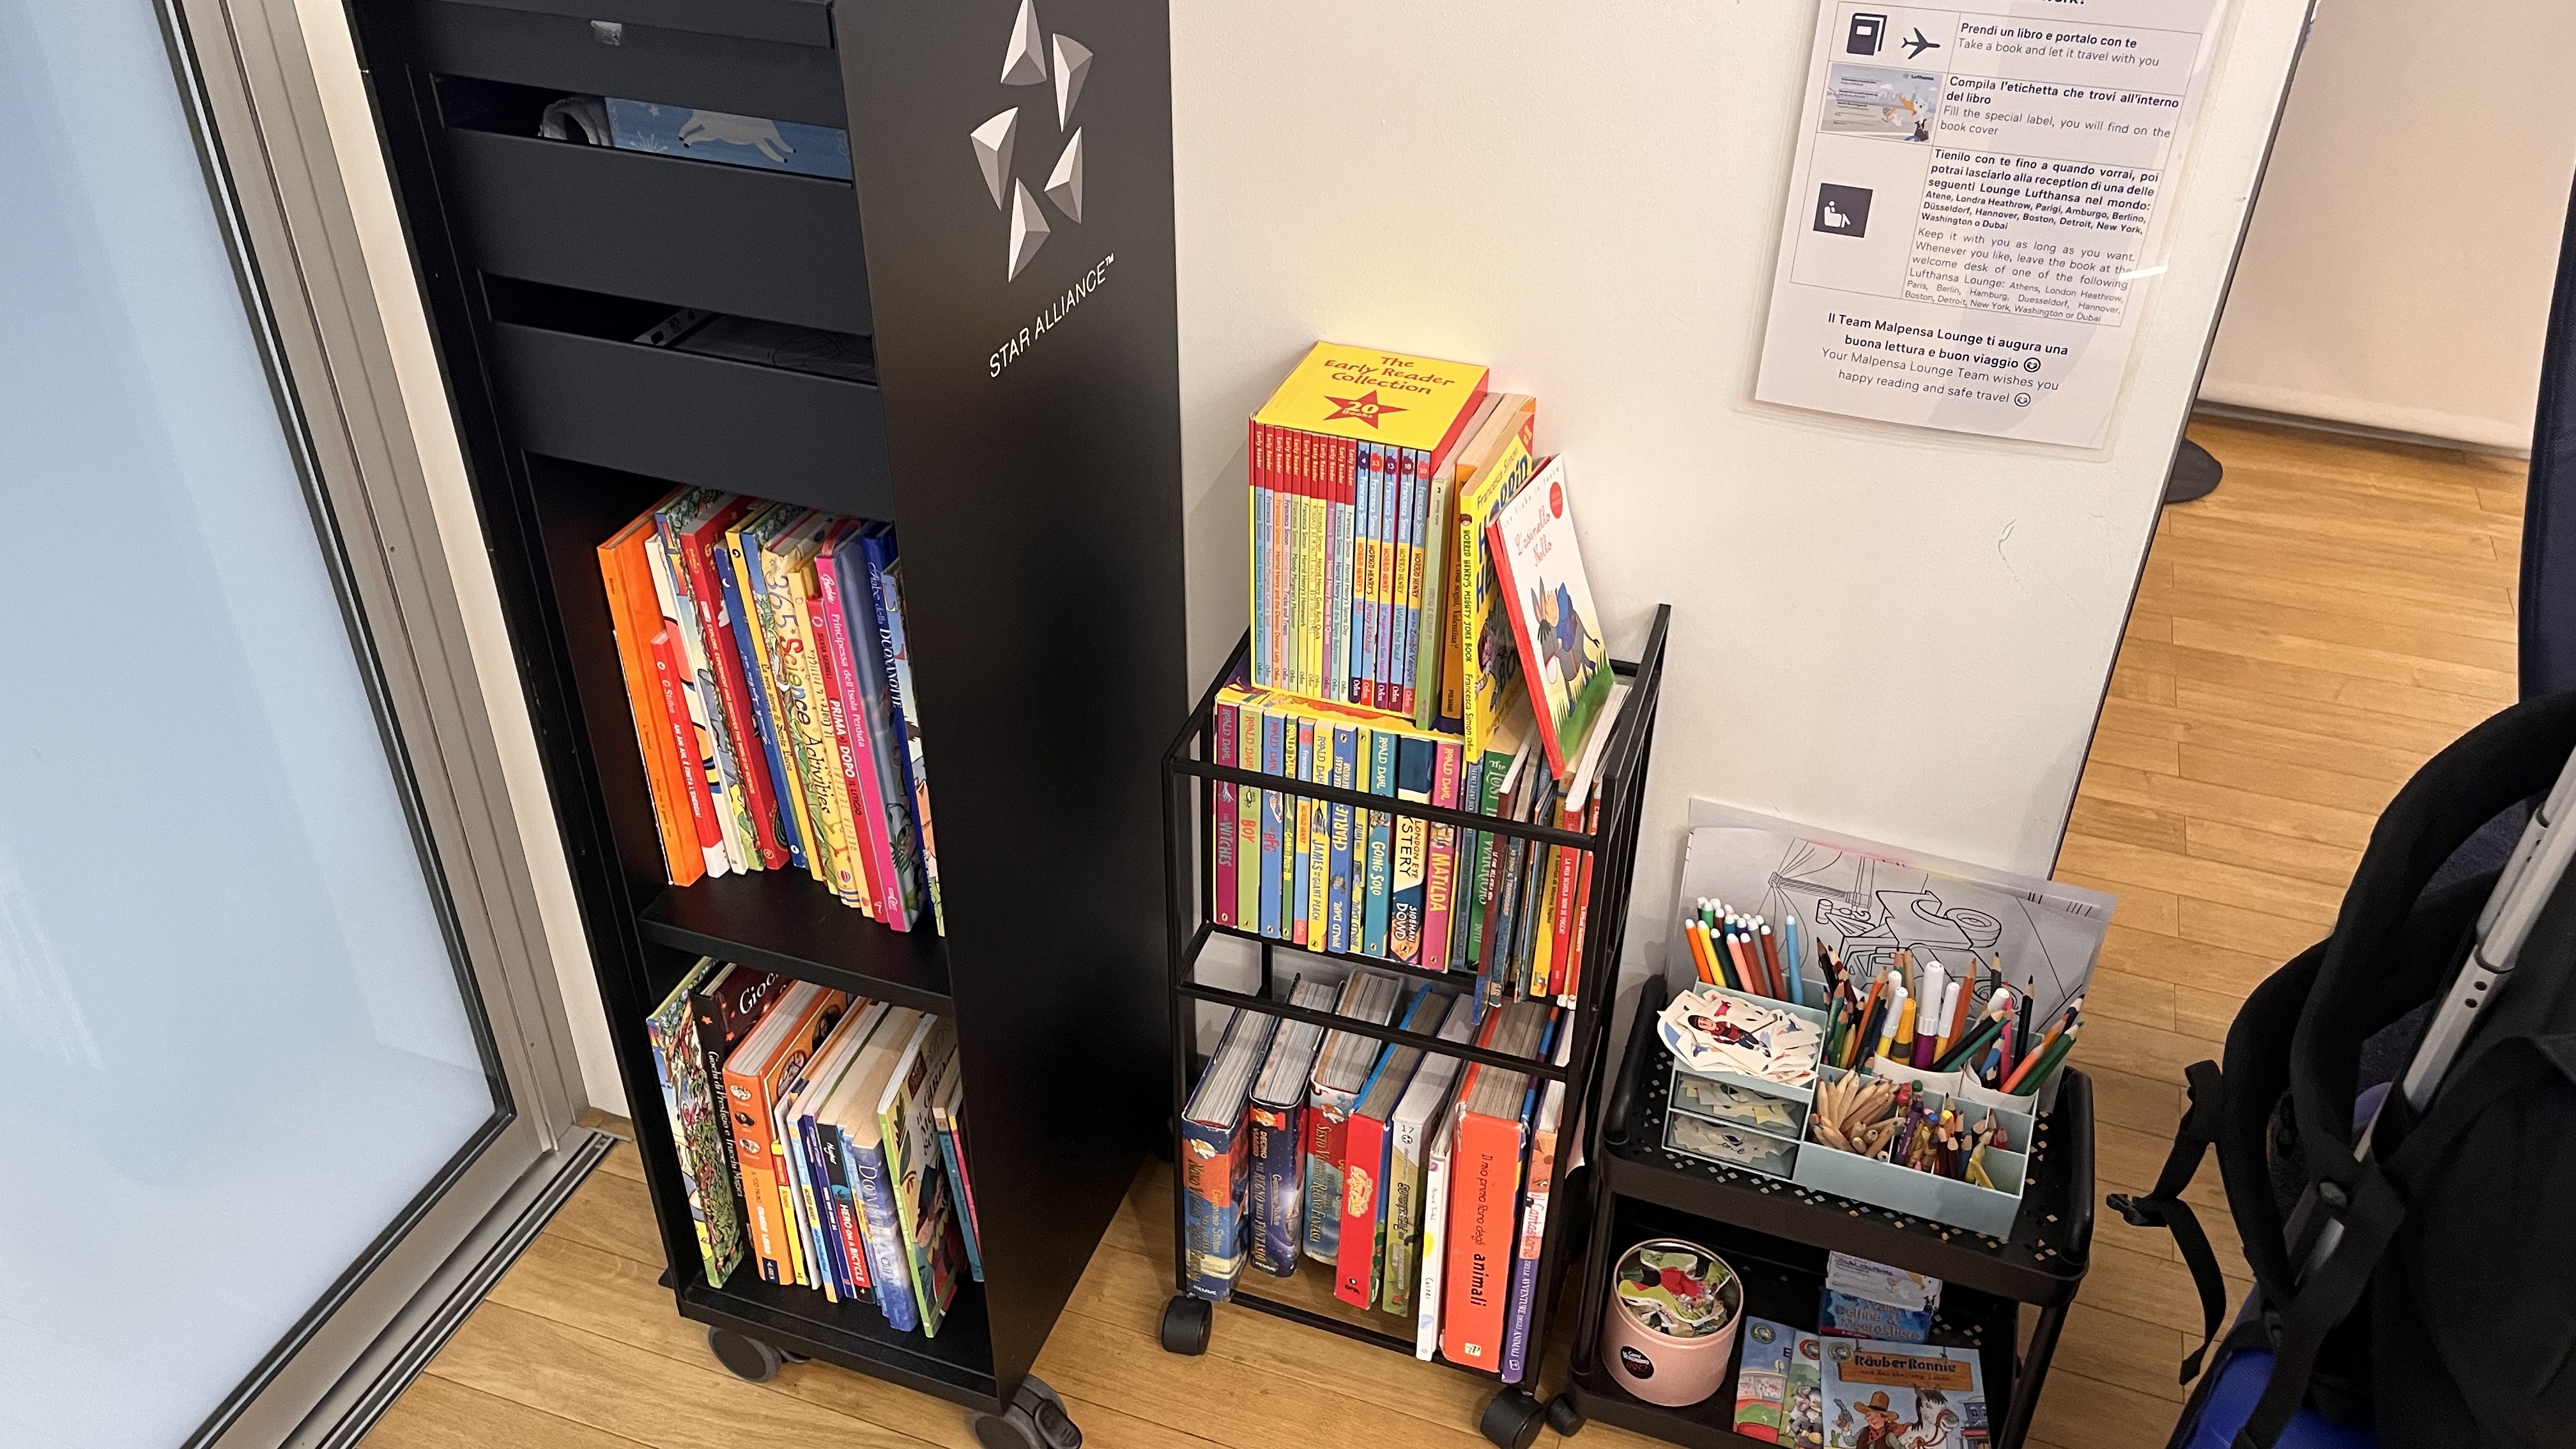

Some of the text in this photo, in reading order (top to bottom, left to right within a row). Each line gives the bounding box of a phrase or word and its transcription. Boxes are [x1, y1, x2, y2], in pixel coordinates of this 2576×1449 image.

[1961, 22, 1997, 35] Prendi
[2000, 29, 2014, 37] un
[2017, 27, 2043, 40] libro
[2055, 34, 2097, 44] portalo
[2100, 38, 2122, 47] con
[2125, 38, 2137, 48] te
[1959, 38, 1983, 50] Take
[1995, 41, 2023, 53] book
[2025, 45, 2046, 56] and
[2048, 46, 2064, 57] let
[2066, 47, 2074, 58] it
[2077, 50, 2109, 61] travel
[2112, 52, 2135, 64] with
[2138, 57, 2159, 67] you
[1946, 91, 1991, 104] del libro
[1950, 76, 1996, 90] Compila
[2000, 80, 2058, 96] l'etichetta
[2063, 88, 2084, 98] che
[2089, 90, 2117, 102] trovi
[2120, 93, 2179, 108] all'interno
[1935, 149, 1970, 162] Tienilo
[1975, 156, 1995, 165] con
[2000, 157, 2011, 166] te
[2016, 158, 2037, 169] fino
[2053, 164, 2095, 175] quando
[2100, 169, 2135, 182] vorrai,
[2140, 172, 2159, 183] poi
[1928, 180, 2150, 210] seguenti Lounge Lufthansa nel mondo:
[1828, 312, 2068, 355] Il Team Malpensa Lounge ti augura una
[990, 327, 1030, 378] STAR
[1381, 356, 1414, 367] The
[1844, 334, 1882, 349] buona
[1885, 341, 1925, 355] lettura
[1938, 348, 1970, 362] buon
[1974, 353, 2018, 369] viaggio
[1324, 360, 1455, 385] Early Reader
[1331, 373, 1431, 394] Collection
[1822, 348, 2059, 391] Your Malpensa Lounge Team wishes you
[1839, 369, 2010, 402] happy reading and safe travel
[1347, 401, 1379, 413] 20
[1359, 477, 1367, 510] Francesca
[1370, 479, 1379, 512] Francesca
[1534, 534, 1552, 567] Nello
[1463, 590, 1472, 619] MIGHTY
[1464, 620, 1472, 640] JOKE
[715, 652, 728, 687] EXPERIMENT
[832, 613, 848, 667] Principessa
[853, 714, 866, 747] Perduta
[723, 688, 732, 702] AND
[766, 574, 831, 813] 365 Science Activities
[726, 702, 739, 730] DISCOVER
[1466, 712, 1474, 735] Simon
[737, 742, 747, 763] WORLD
[830, 700, 856, 778] PRIMA DOPO
[1377, 737, 1388, 788] ROALD DAHL
[1441, 747, 1453, 801] ROALD DAHL
[1241, 819, 1256, 843] BOY
[1333, 806, 1349, 851] CHARLIE
[1312, 839, 1324, 871] JAMES
[1399, 817, 1414, 877] YSTERY
[1411, 820, 1422, 880] LONDON EYE
[1370, 841, 1386, 896] GOING SOLO
[1430, 852, 1451, 912] MATILDA
[1395, 903, 1409, 940] DOWD
[1407, 905, 1418, 943] SIOBHAN
[714, 1081, 725, 1090] di
[1402, 1125, 1414, 1133] 17
[839, 1204, 853, 1228] HERO
[845, 1229, 854, 1240] ON
[849, 1247, 865, 1282] BICYCLE
[1471, 1254, 1489, 1307] animali
[1888, 1314, 1897, 1325] &
[1855, 1356, 1907, 1368] Räuber
